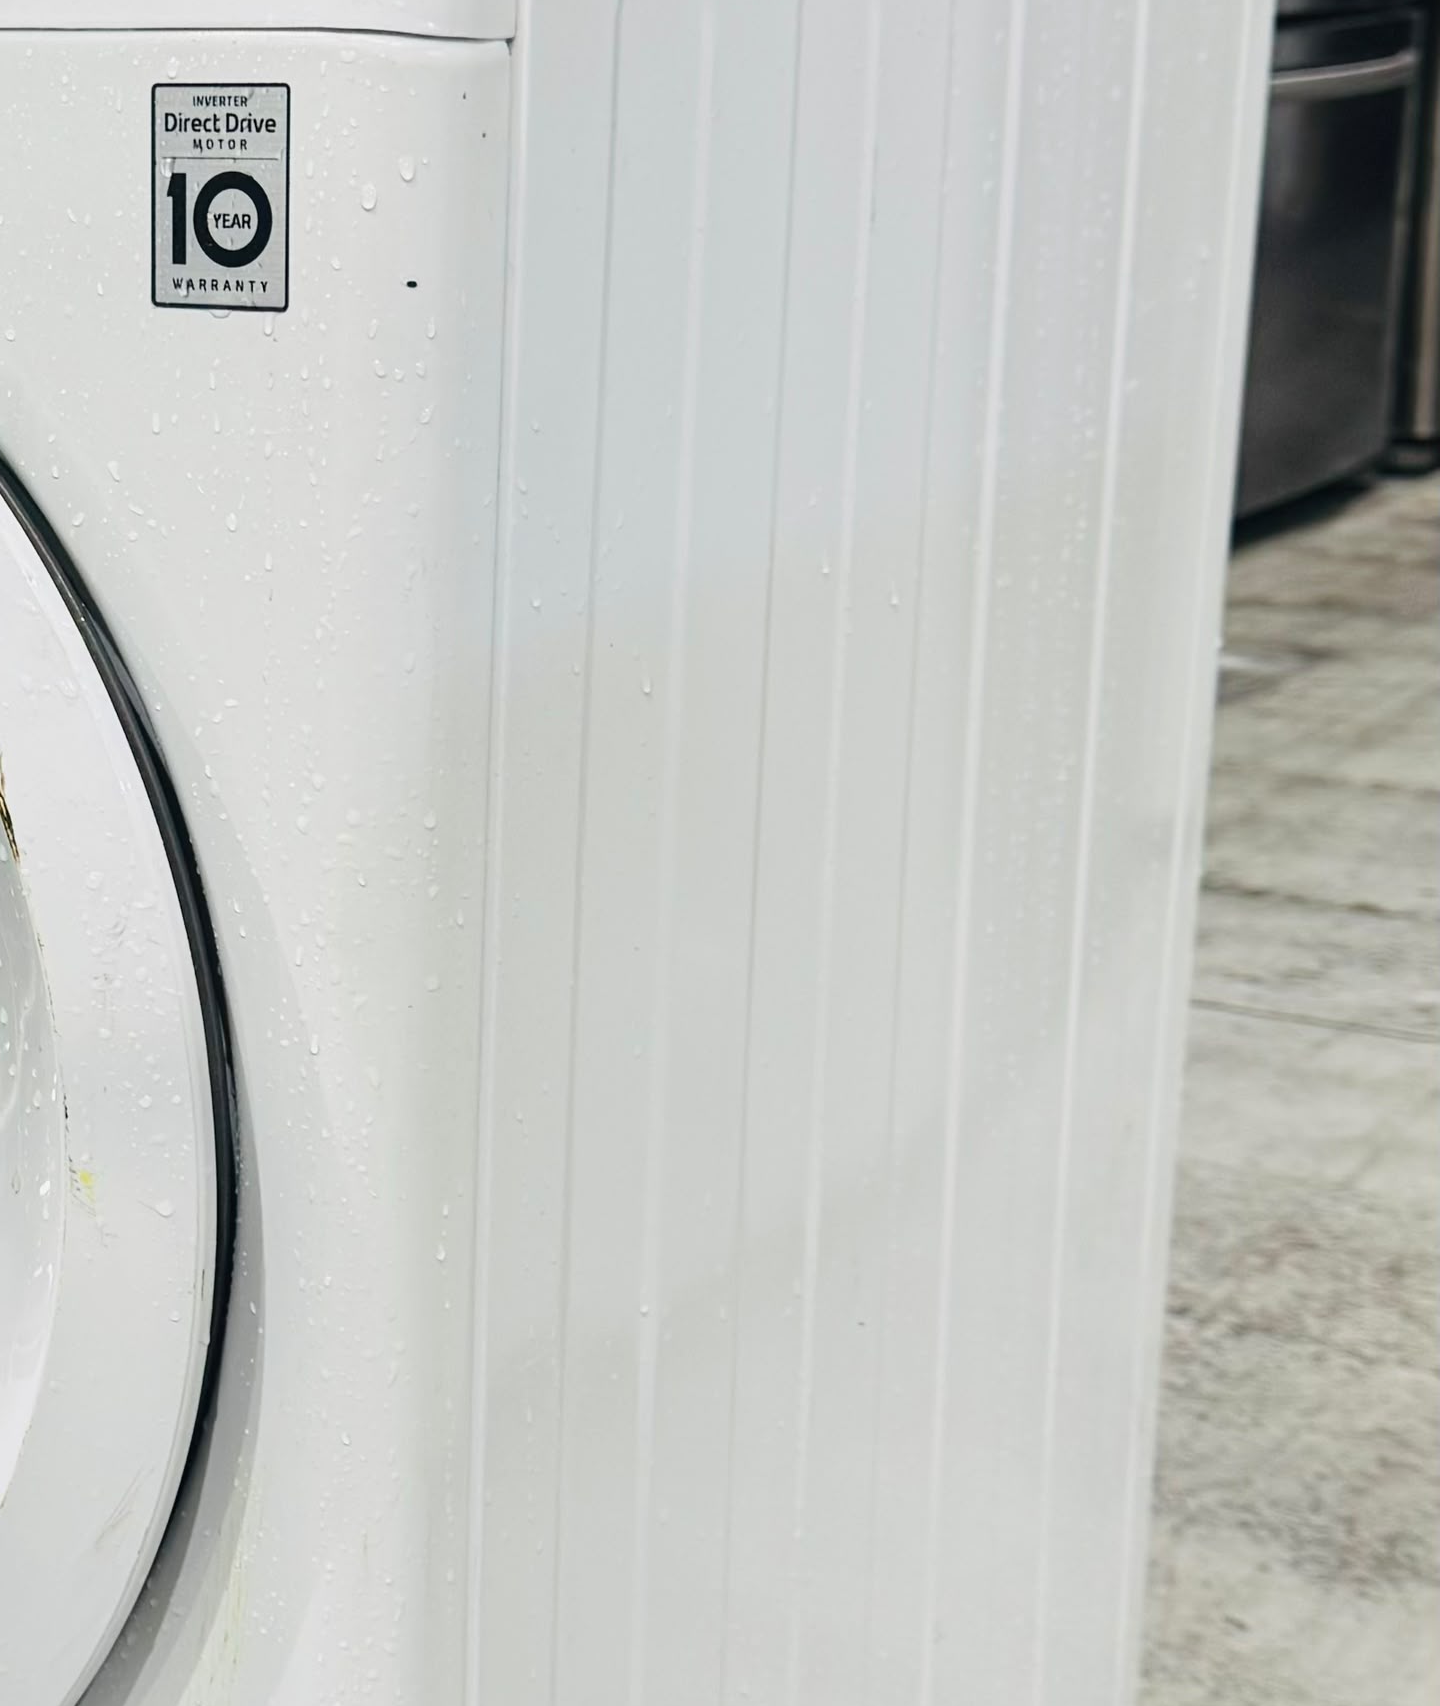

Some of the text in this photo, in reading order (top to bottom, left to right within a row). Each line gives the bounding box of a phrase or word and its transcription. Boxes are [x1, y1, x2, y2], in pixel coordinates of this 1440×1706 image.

[192, 95, 248, 107] INVERTER
[164, 112, 277, 134] Direct Drive
[193, 139, 248, 152] MOTOR
[167, 170, 273, 269] 10
[213, 213, 252, 230] YEAR
[172, 277, 269, 294] WARRANTY
